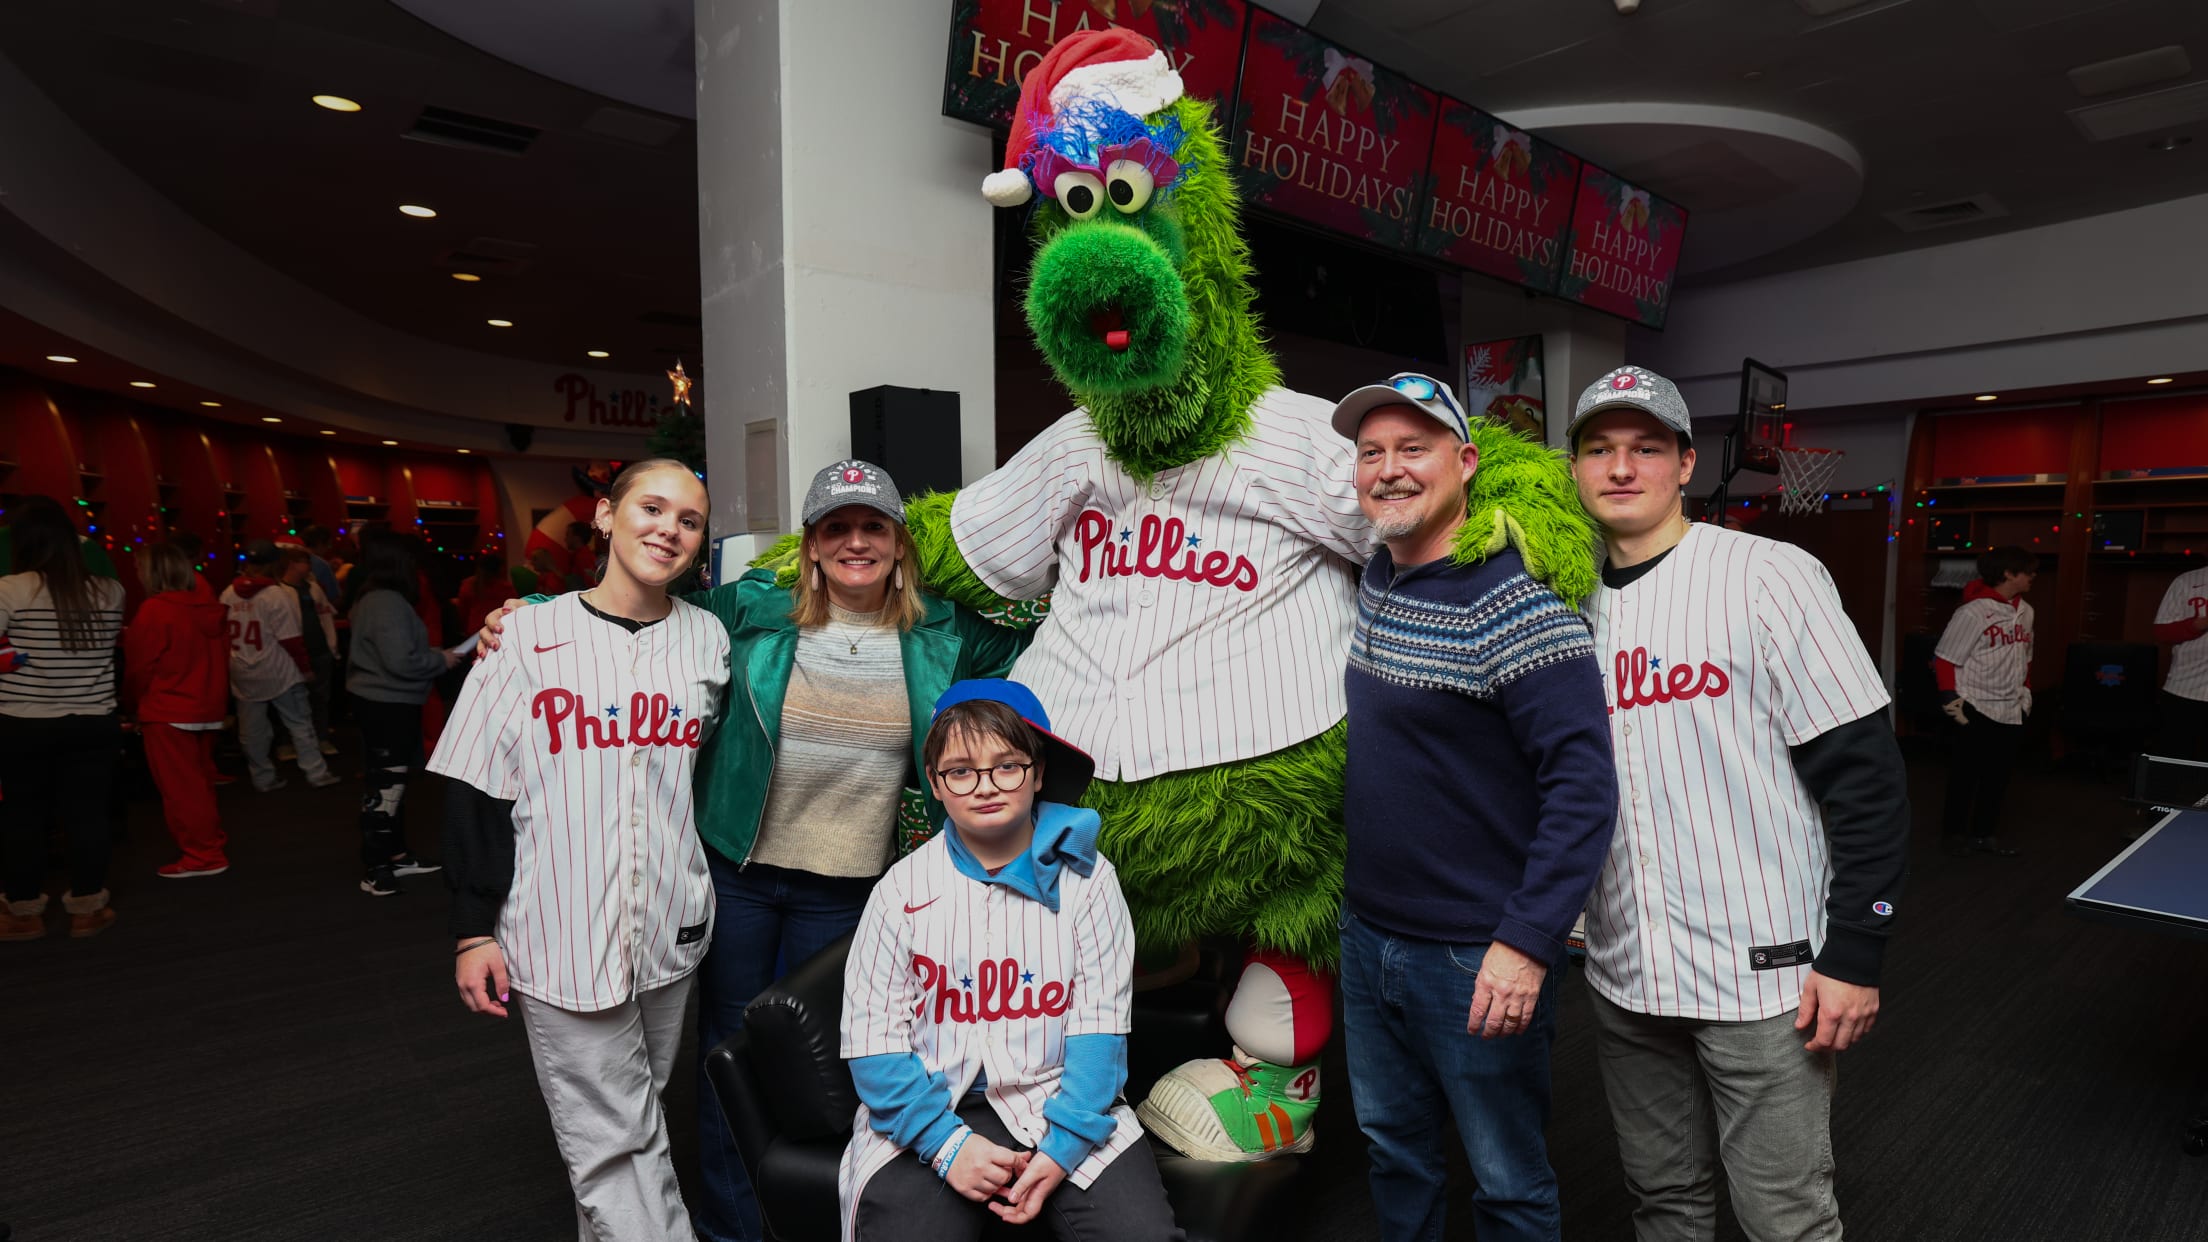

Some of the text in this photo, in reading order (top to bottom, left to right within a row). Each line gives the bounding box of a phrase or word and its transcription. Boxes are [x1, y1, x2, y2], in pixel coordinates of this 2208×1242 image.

[1277, 92, 1400, 174] HAPPY
[1241, 130, 1414, 224] HOLIDAYS!
[1456, 164, 1550, 228] HAPPY
[1428, 196, 1559, 269] HOLIDAYS!
[1591, 220, 1663, 271] HAPPY
[1569, 248, 1668, 307] HOLIDAYS!
[847, 469, 859, 481] P
[1075, 509, 1259, 592] Phillies
[1607, 646, 1730, 715] llies
[532, 687, 704, 755] Phillie
[912, 953, 1075, 1025] Phillie
[1294, 1068, 1317, 1102] P
